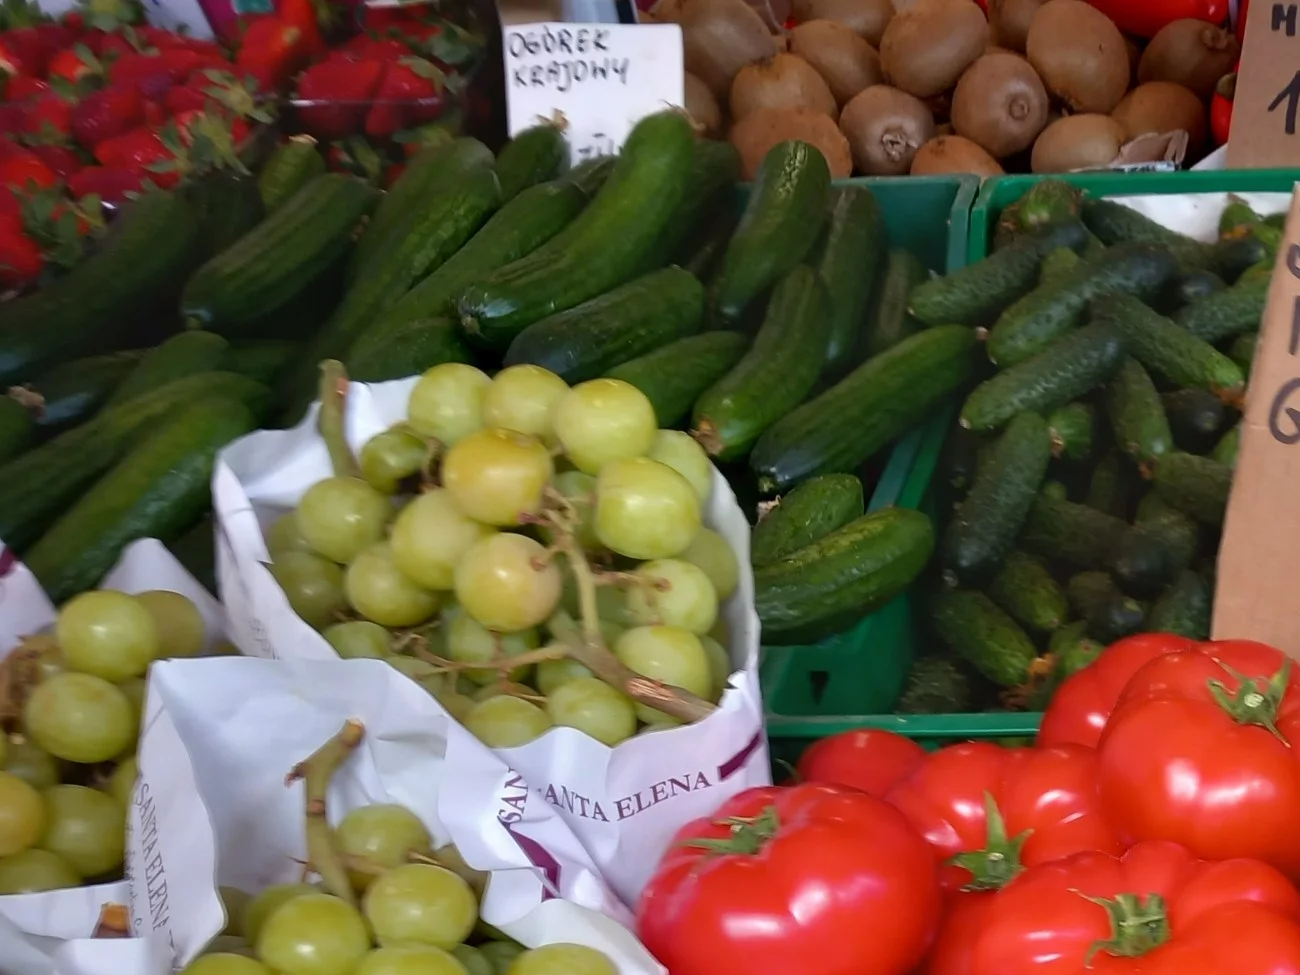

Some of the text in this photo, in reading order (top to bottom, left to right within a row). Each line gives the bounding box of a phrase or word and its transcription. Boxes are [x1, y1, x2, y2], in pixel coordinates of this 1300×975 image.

[509, 24, 611, 59] OGÓREK
[513, 57, 629, 93] KRAJOWY
[497, 766, 529, 826] SAN
[542, 770, 713, 824] ANTA ELENA
